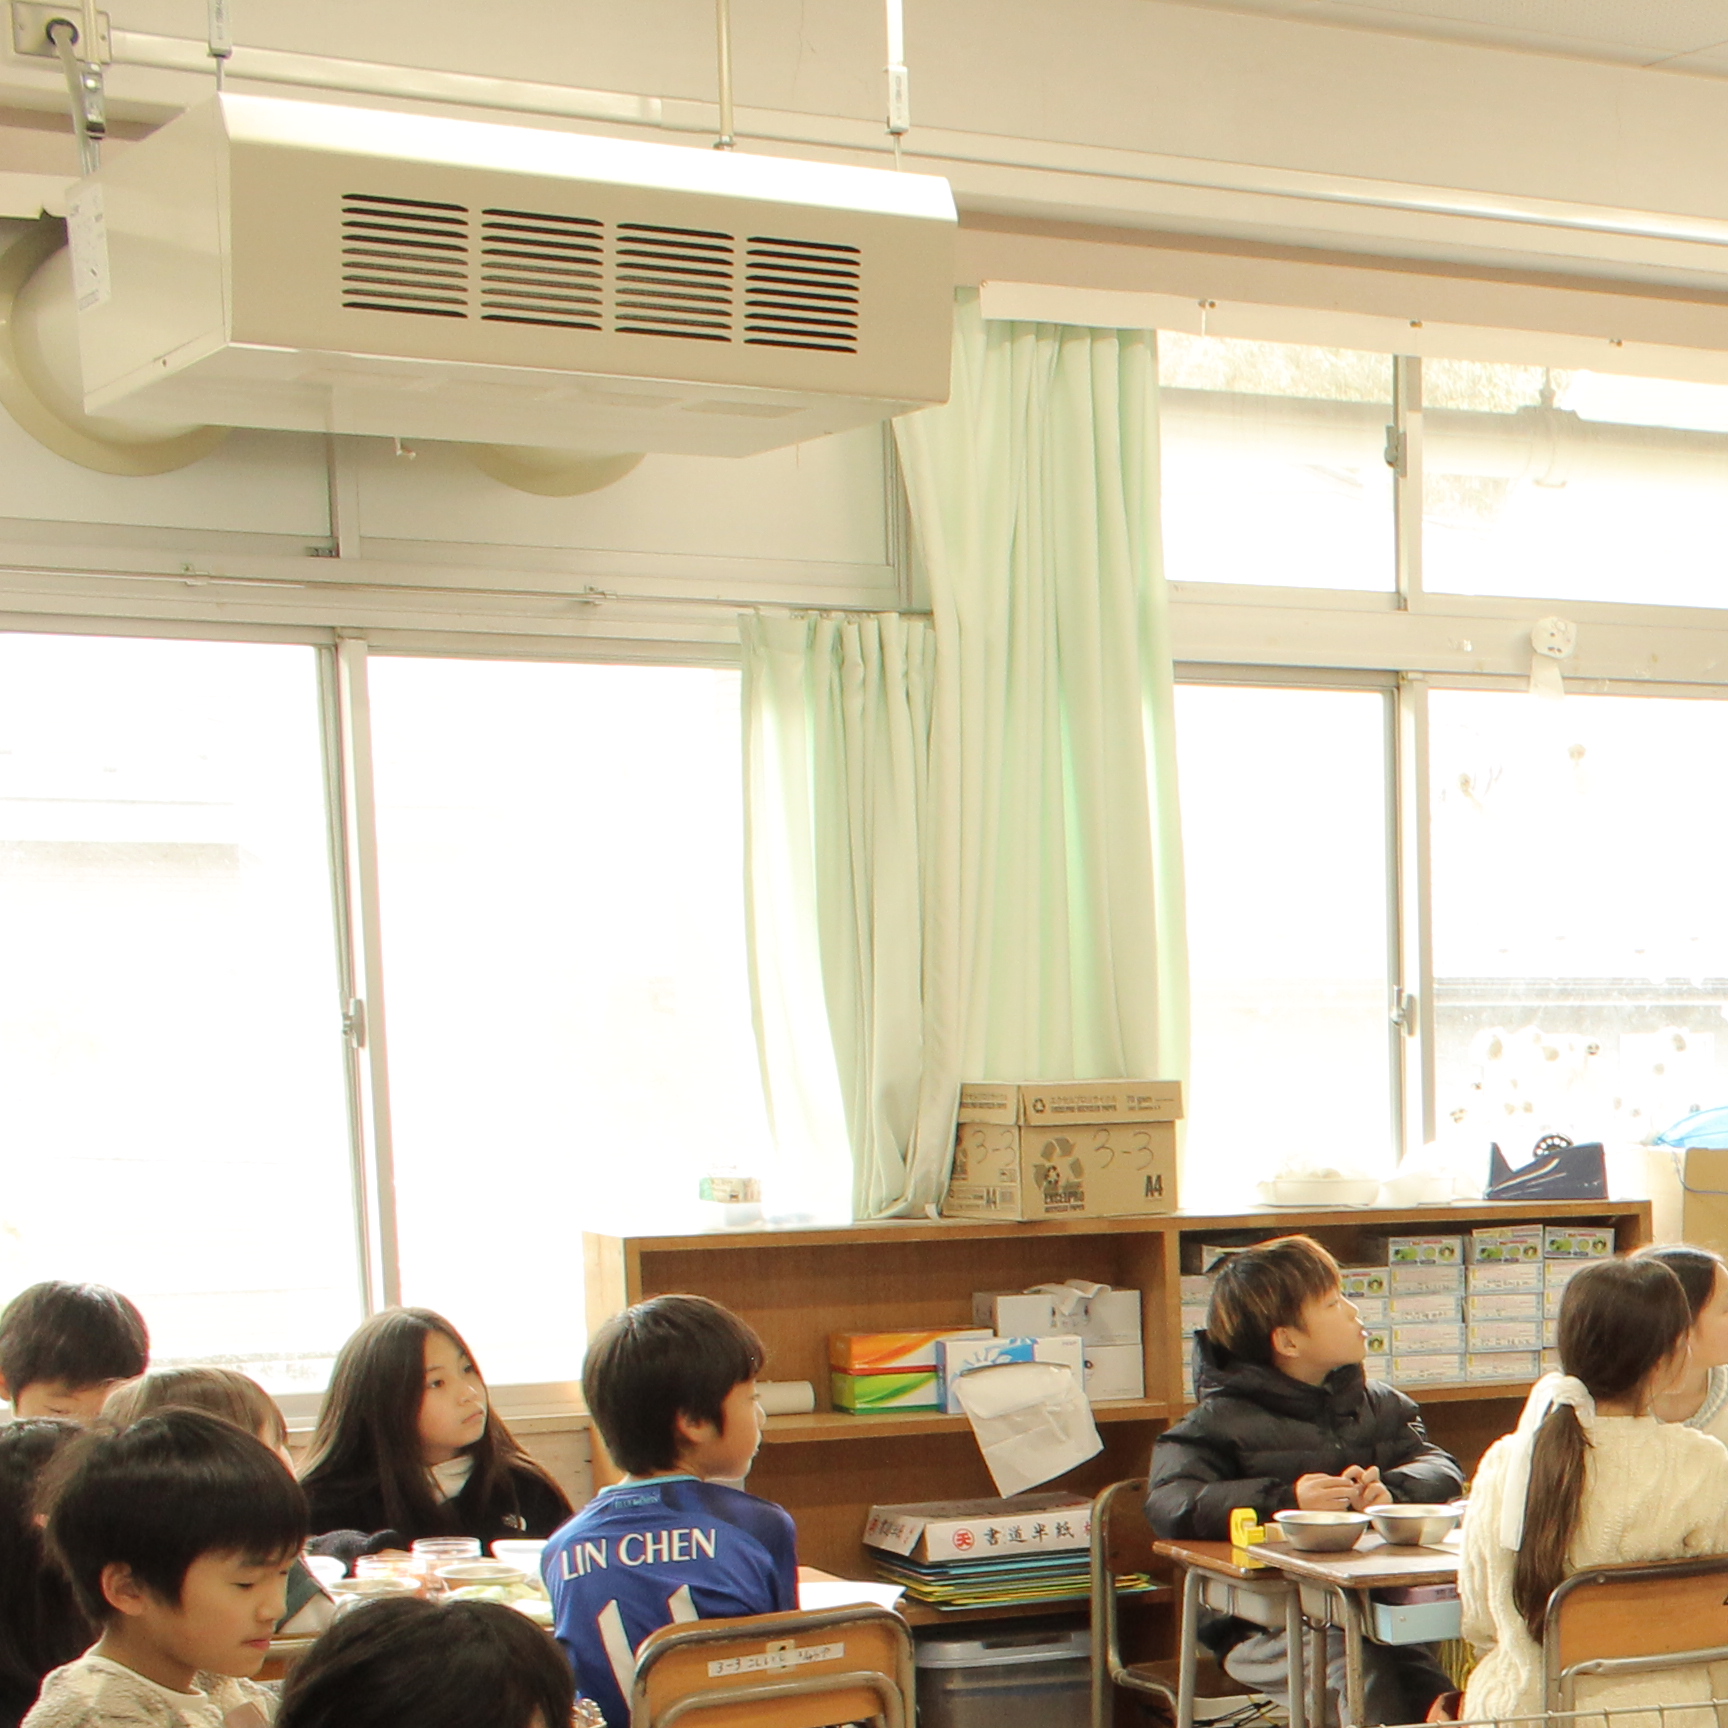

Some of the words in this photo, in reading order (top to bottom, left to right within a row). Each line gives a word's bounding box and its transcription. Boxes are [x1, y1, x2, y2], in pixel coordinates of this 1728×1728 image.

[1092, 1128, 1155, 1171] 3-3
[1145, 1175, 1163, 1198] A4
[983, 1521, 1076, 1546] 書道半紙
[559, 1538, 609, 1582] LIN
[616, 1527, 717, 1567] CHEN
